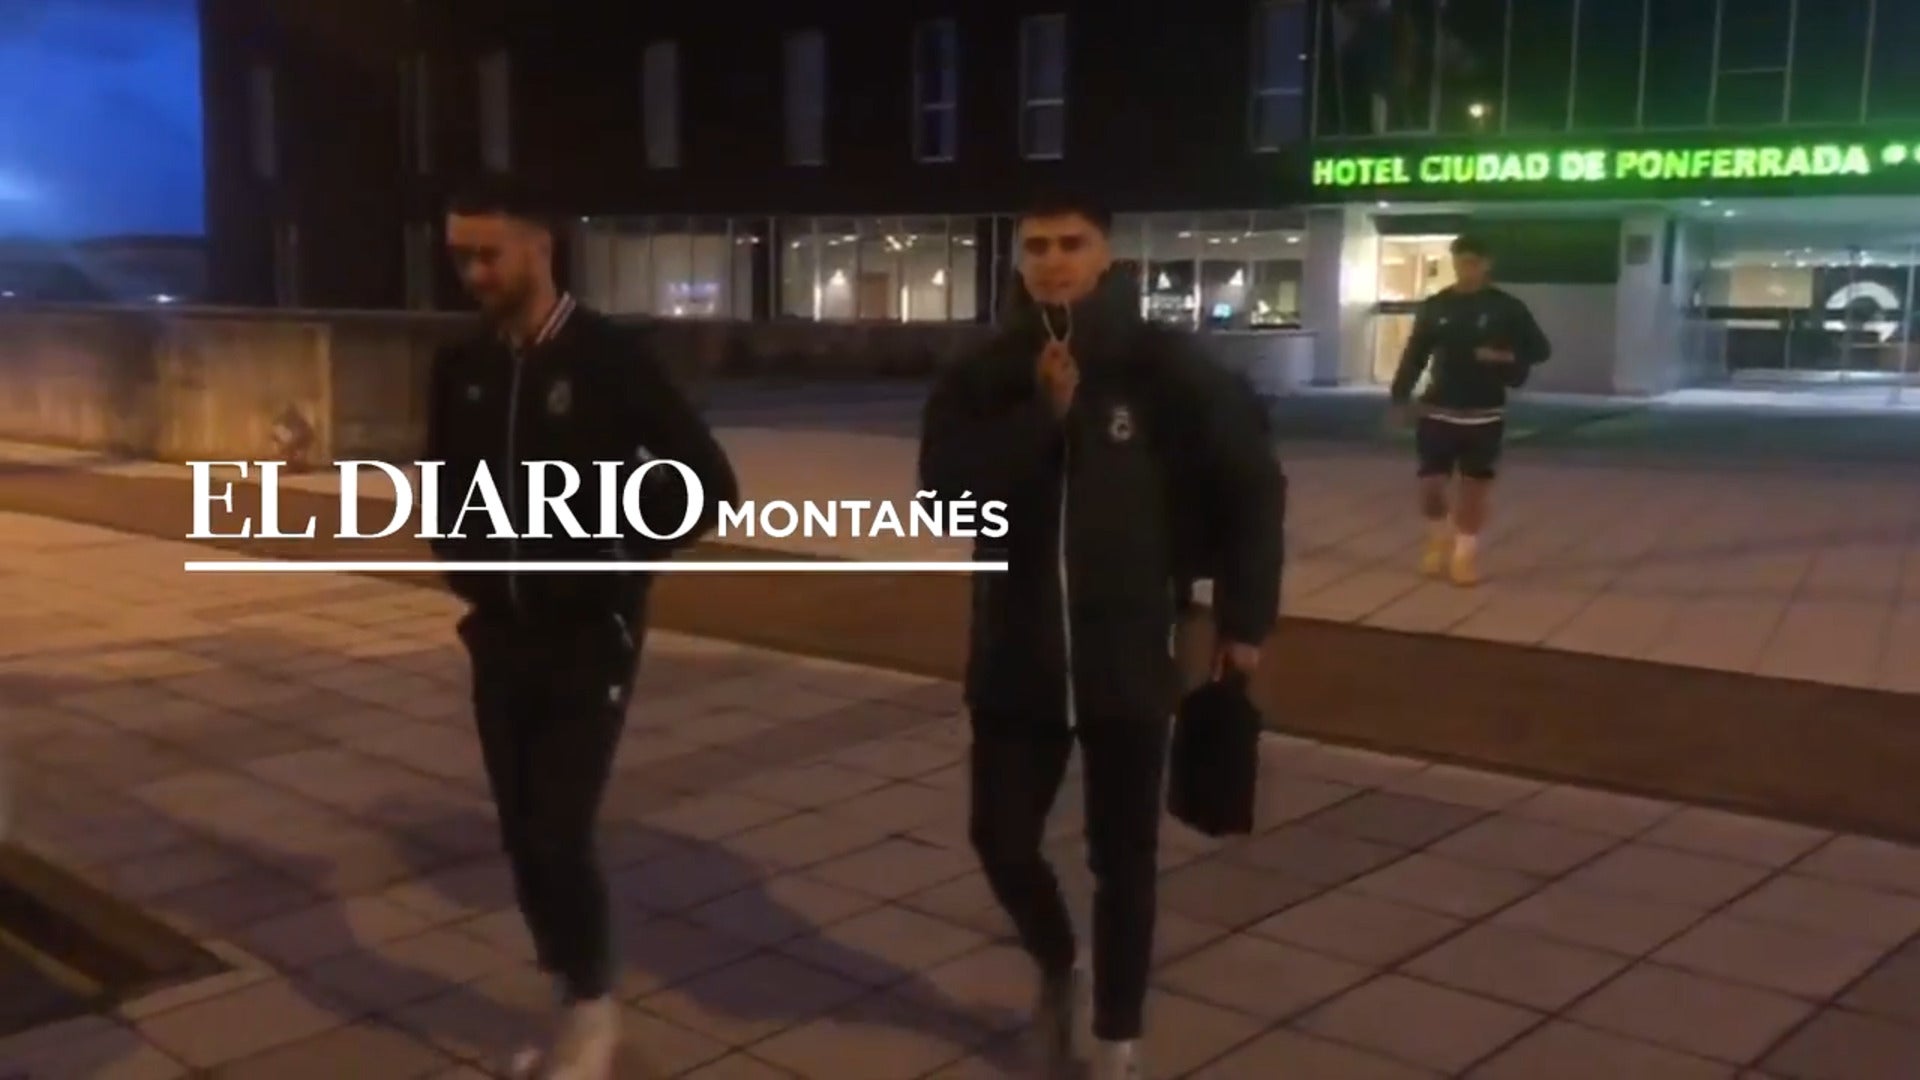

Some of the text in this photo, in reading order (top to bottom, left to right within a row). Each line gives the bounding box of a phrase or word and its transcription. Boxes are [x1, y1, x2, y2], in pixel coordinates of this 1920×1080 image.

[1312, 145, 1870, 186] HOTEL CIUDAD DE PONFERRADA
